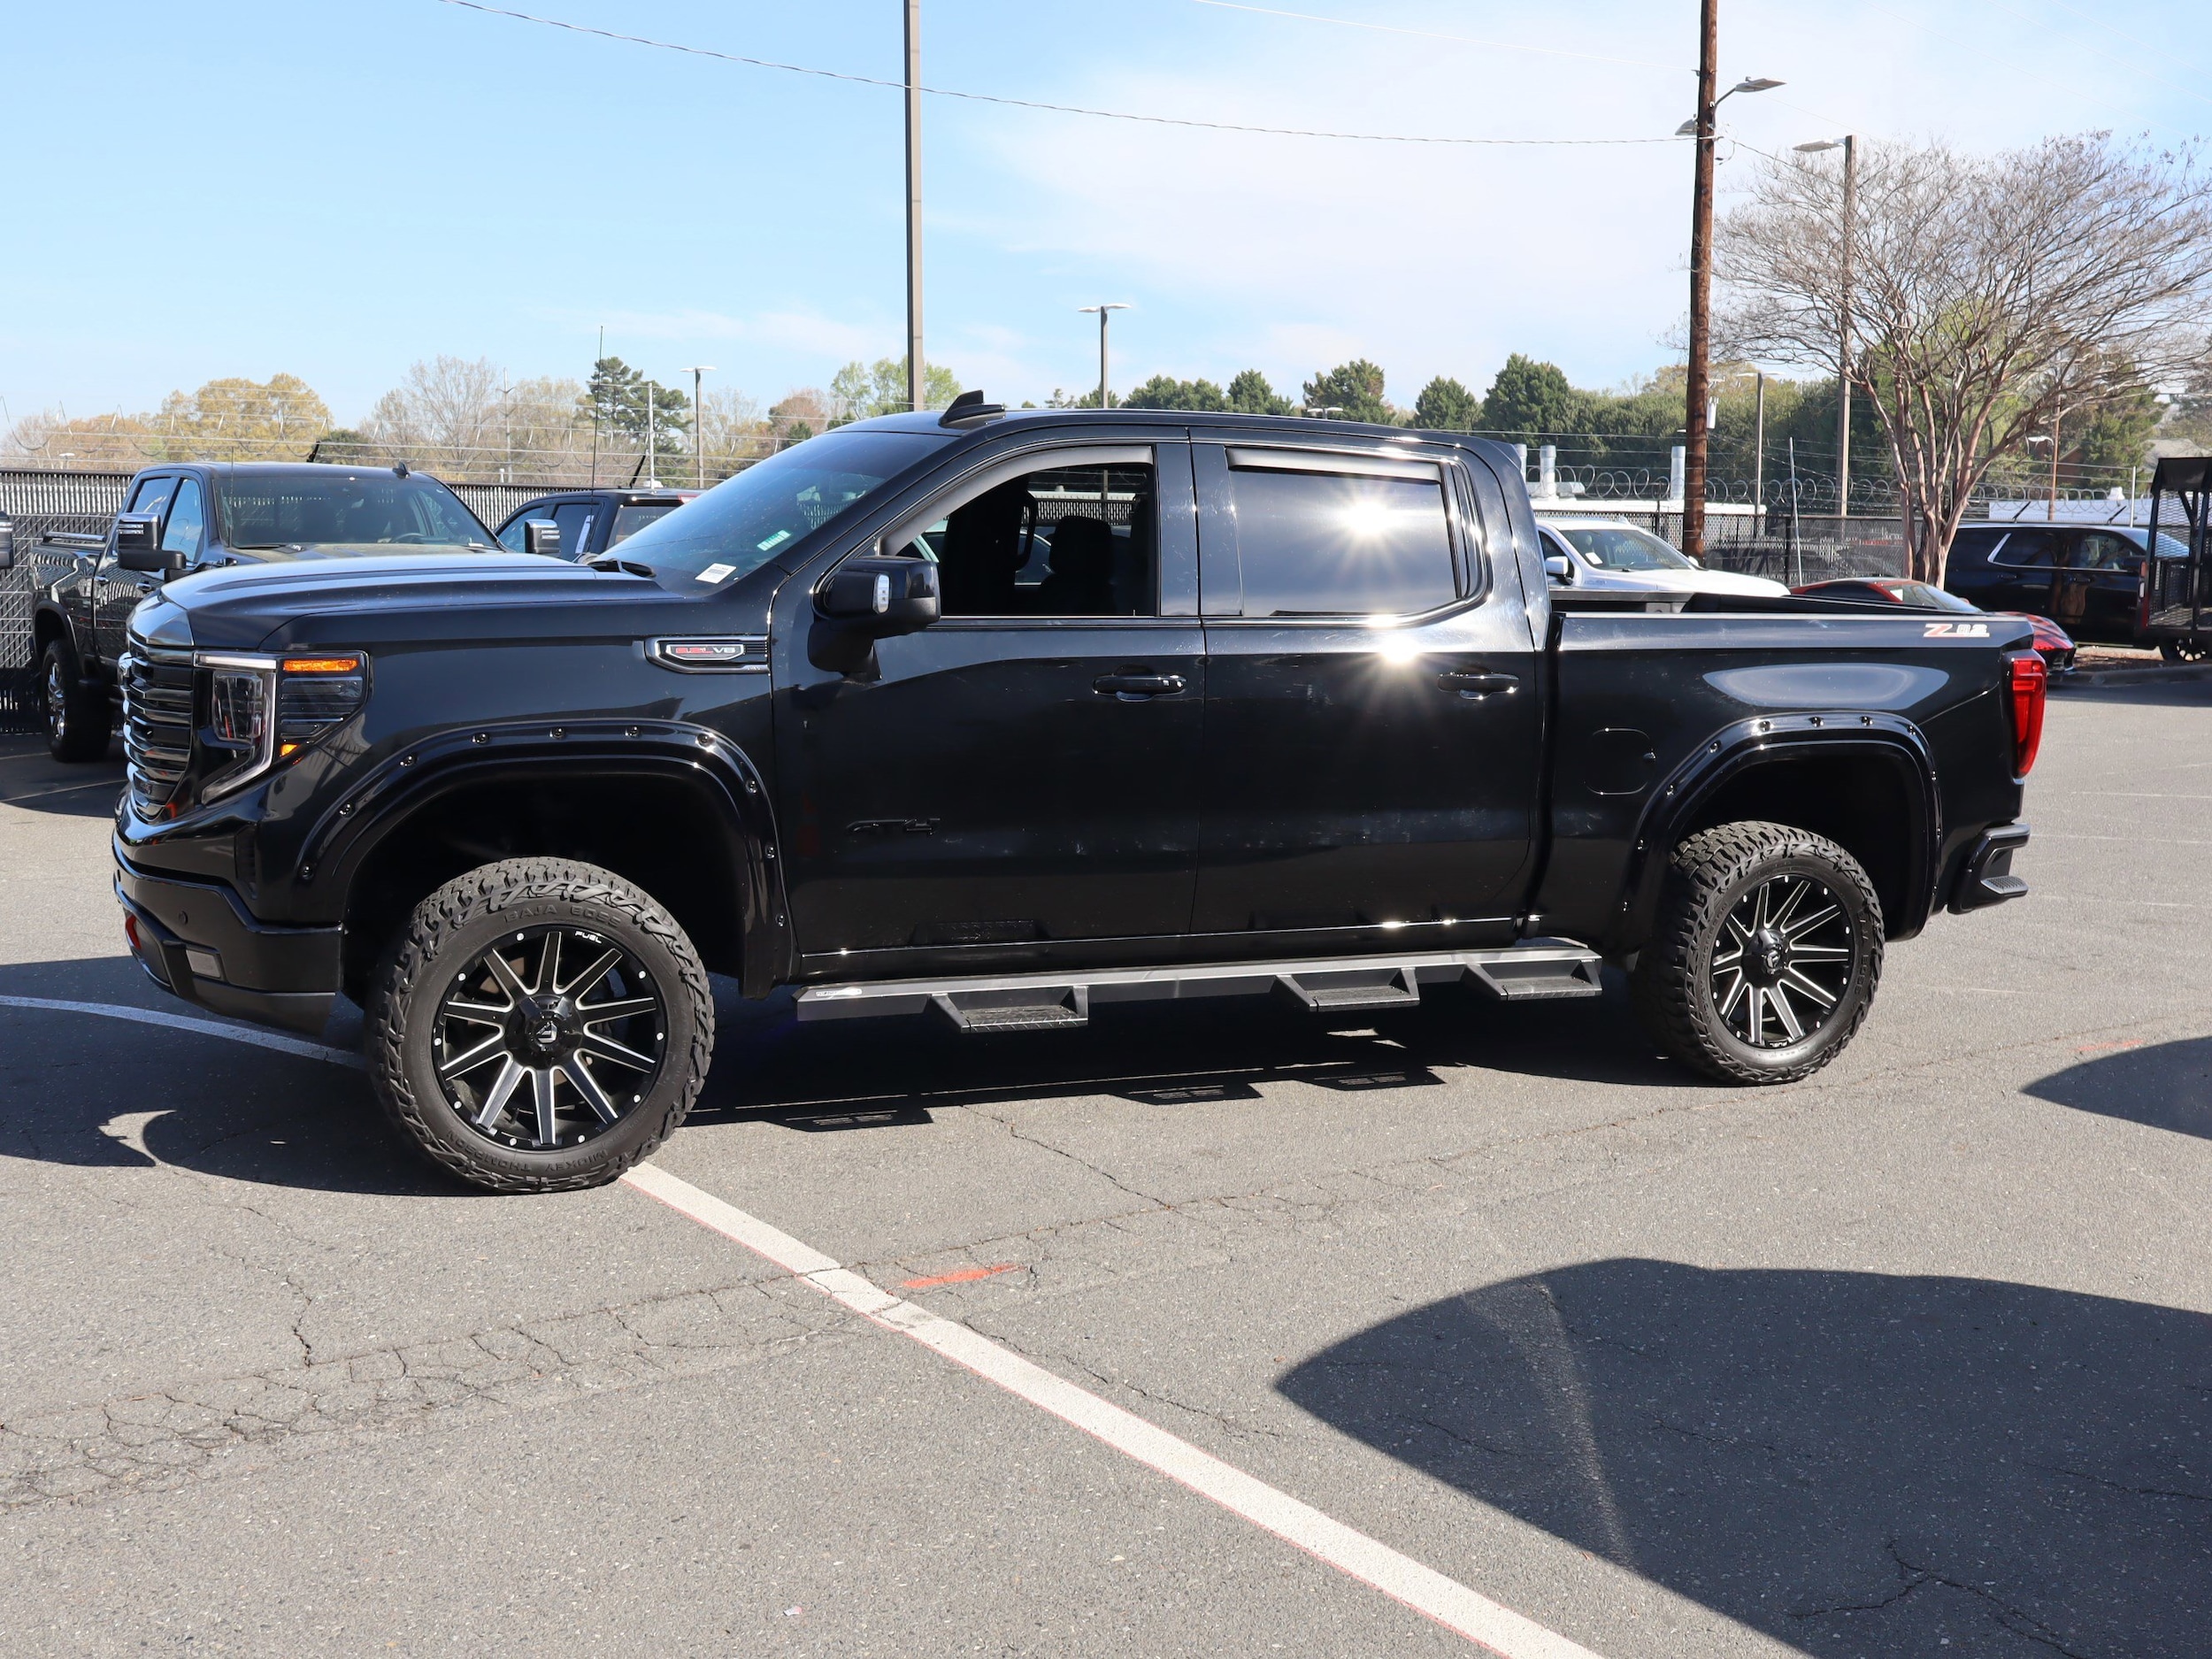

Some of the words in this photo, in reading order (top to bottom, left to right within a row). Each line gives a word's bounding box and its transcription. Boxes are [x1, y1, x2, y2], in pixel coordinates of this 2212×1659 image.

[503, 903, 557, 923] BAJA
[570, 904, 622, 927] BOSS
[574, 930, 603, 944] FUEL
[446, 1130, 532, 1172] THOMPSON
